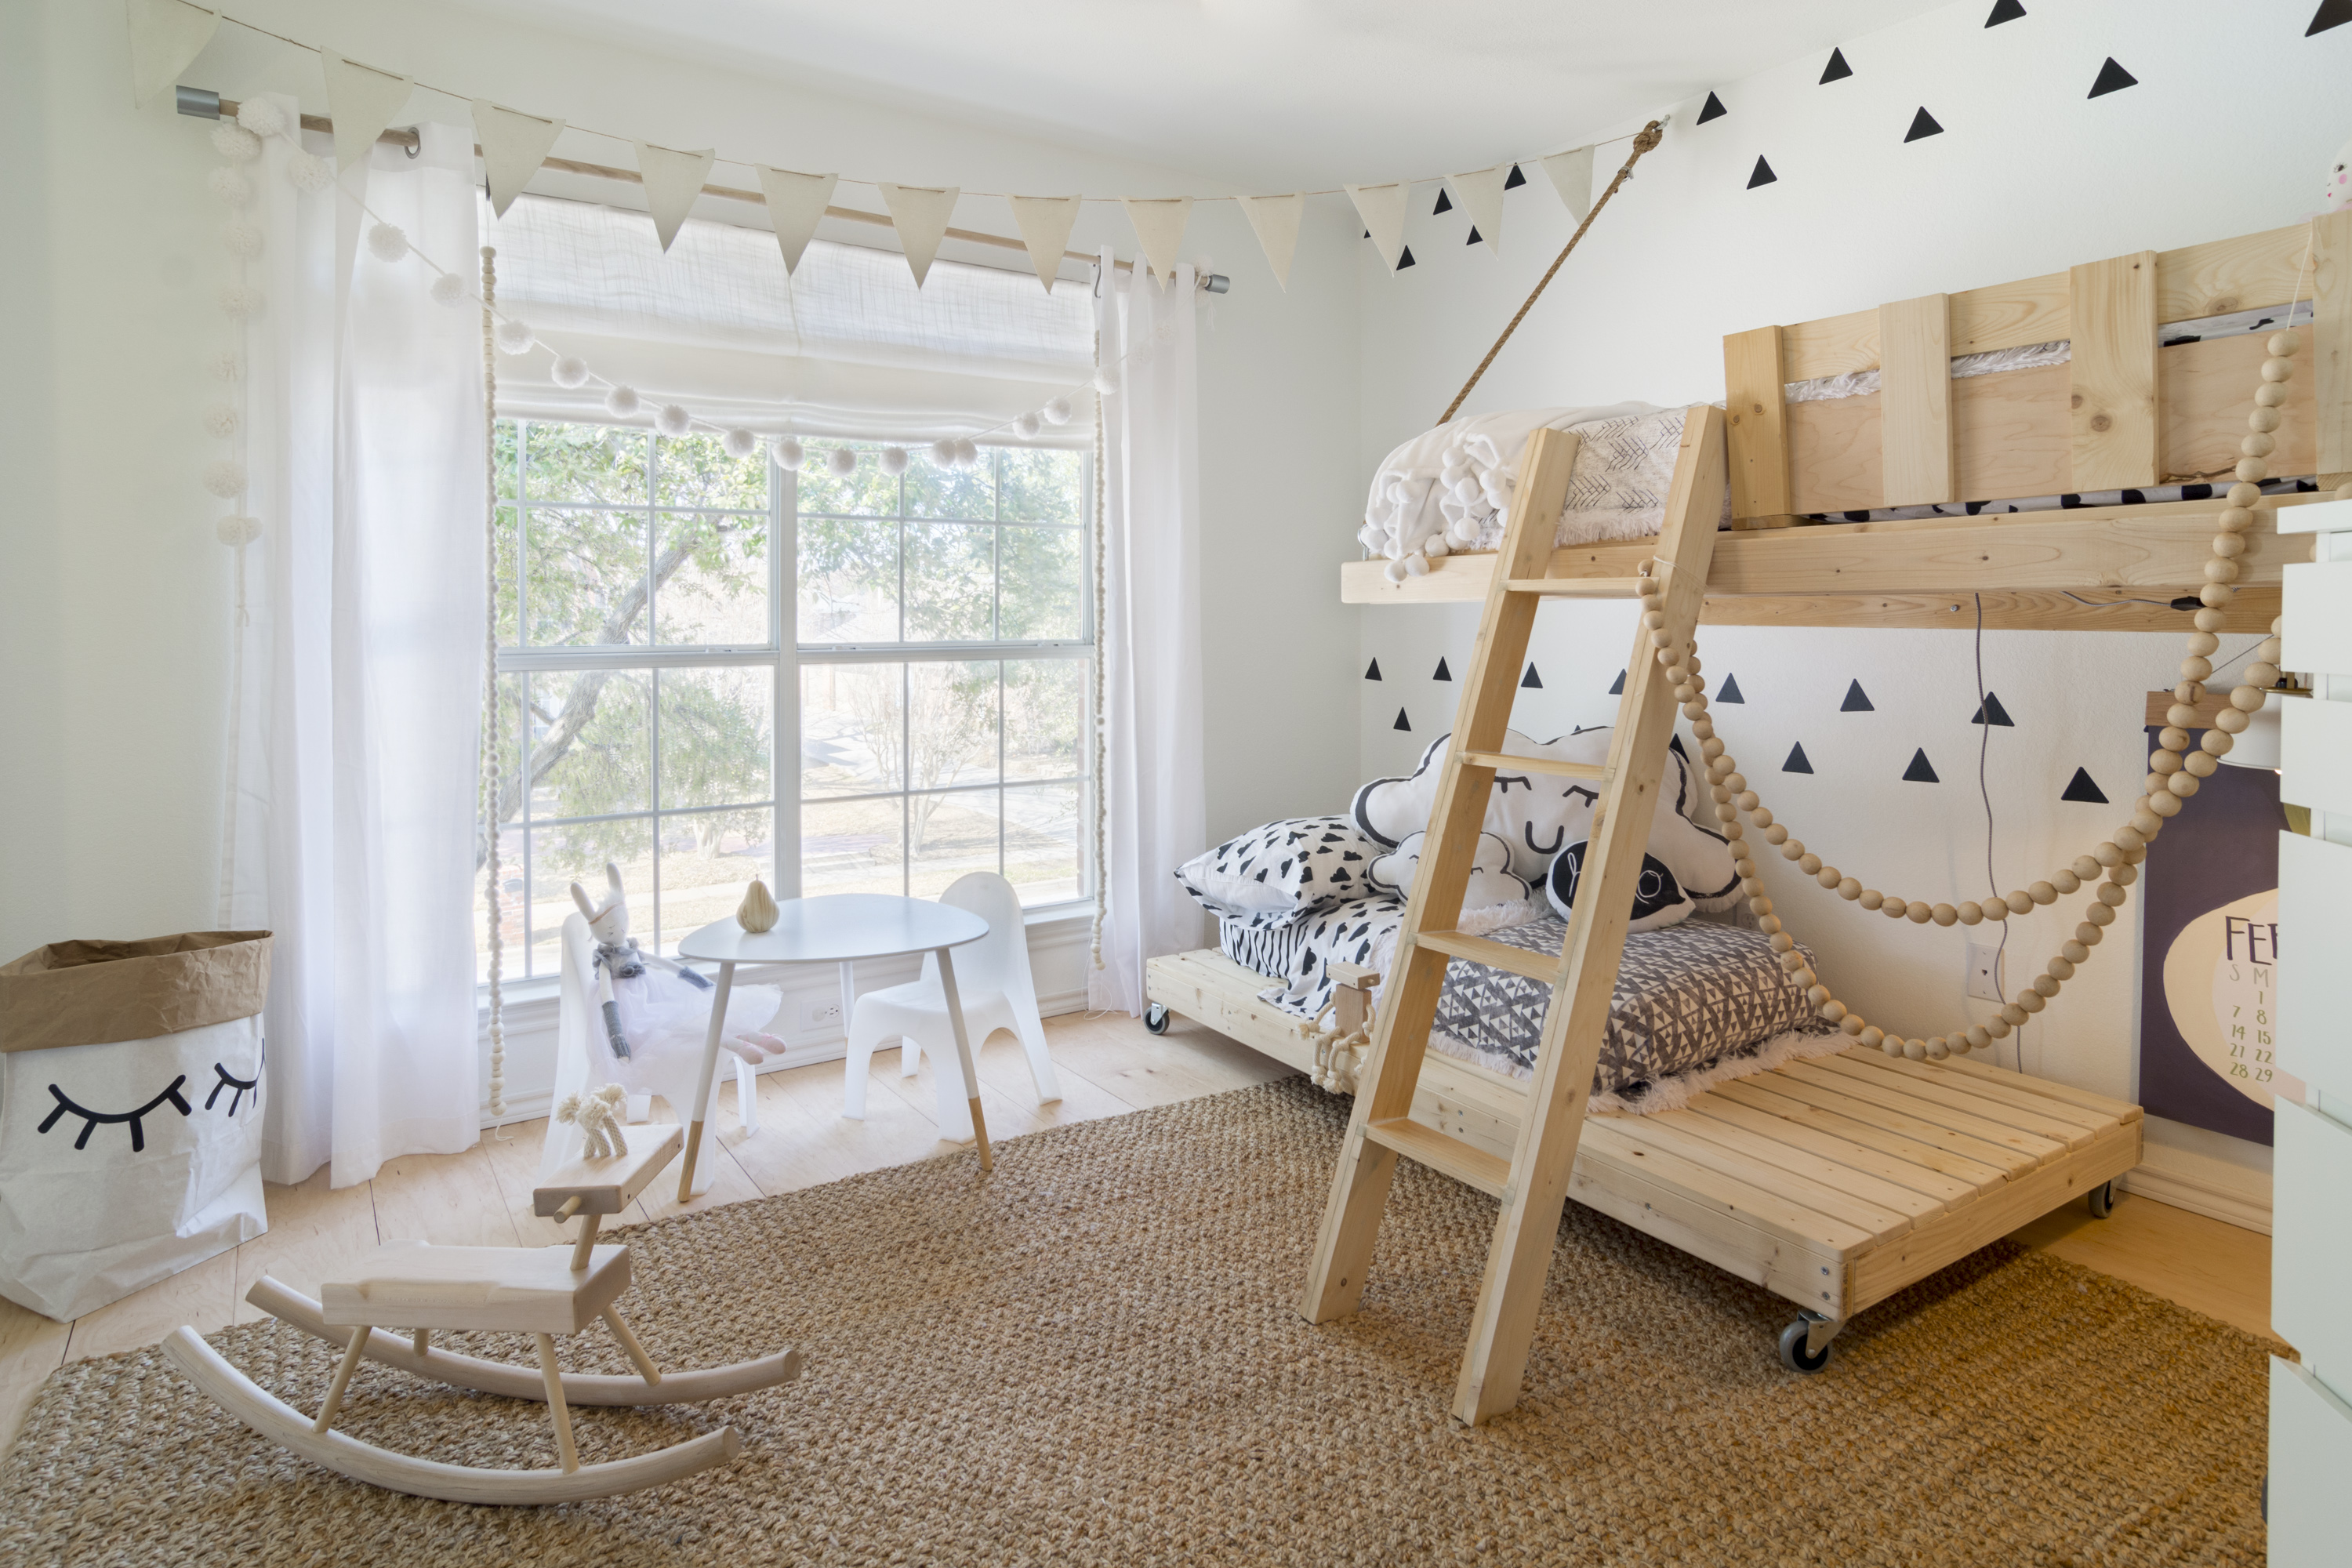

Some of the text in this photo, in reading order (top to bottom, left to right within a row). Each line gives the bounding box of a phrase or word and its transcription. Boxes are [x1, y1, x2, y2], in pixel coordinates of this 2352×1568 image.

[2229, 964, 2269, 988] S M
[2259, 991, 2263, 1004] 1
[2233, 1005, 2267, 1025] 7 8
[2231, 1024, 2271, 1045] 14 15
[2230, 1043, 2273, 1065] 21 22
[2230, 1062, 2273, 1083] 28 29
